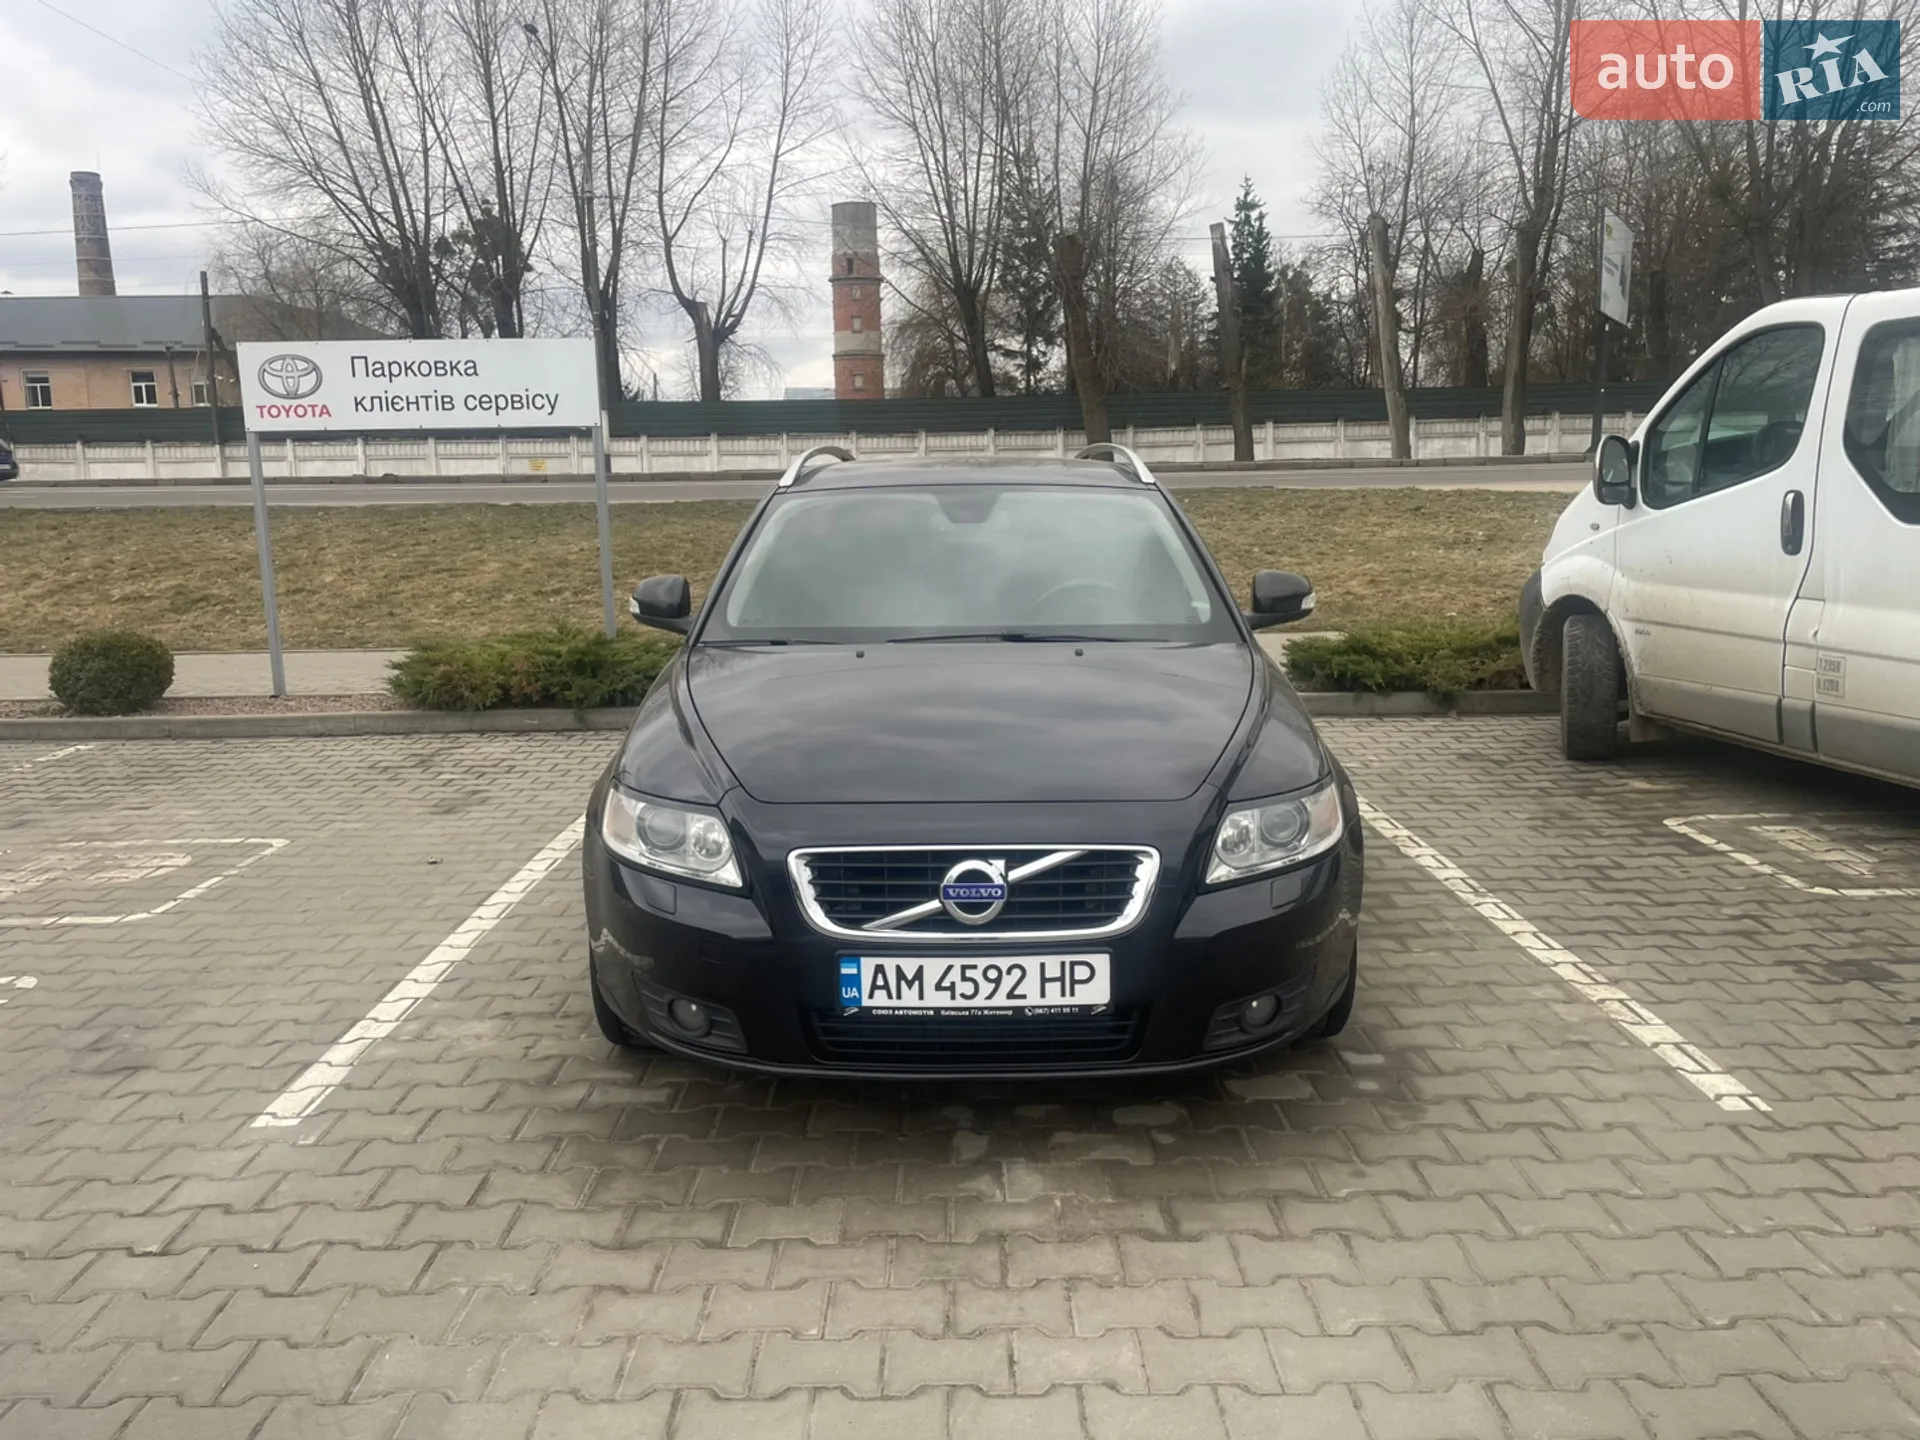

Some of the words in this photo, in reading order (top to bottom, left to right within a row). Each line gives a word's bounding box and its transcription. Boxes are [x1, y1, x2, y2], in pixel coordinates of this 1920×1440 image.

[350, 355, 479, 383] Парковка
[255, 403, 332, 419] TOYOTA
[354, 390, 456, 413] клієнтів
[463, 388, 559, 416] сервісу
[946, 887, 1003, 898] VOLVO
[867, 963, 924, 1001] AM
[934, 964, 1027, 1001] 4592
[1039, 960, 1096, 998] HP
[842, 987, 859, 999] UA
